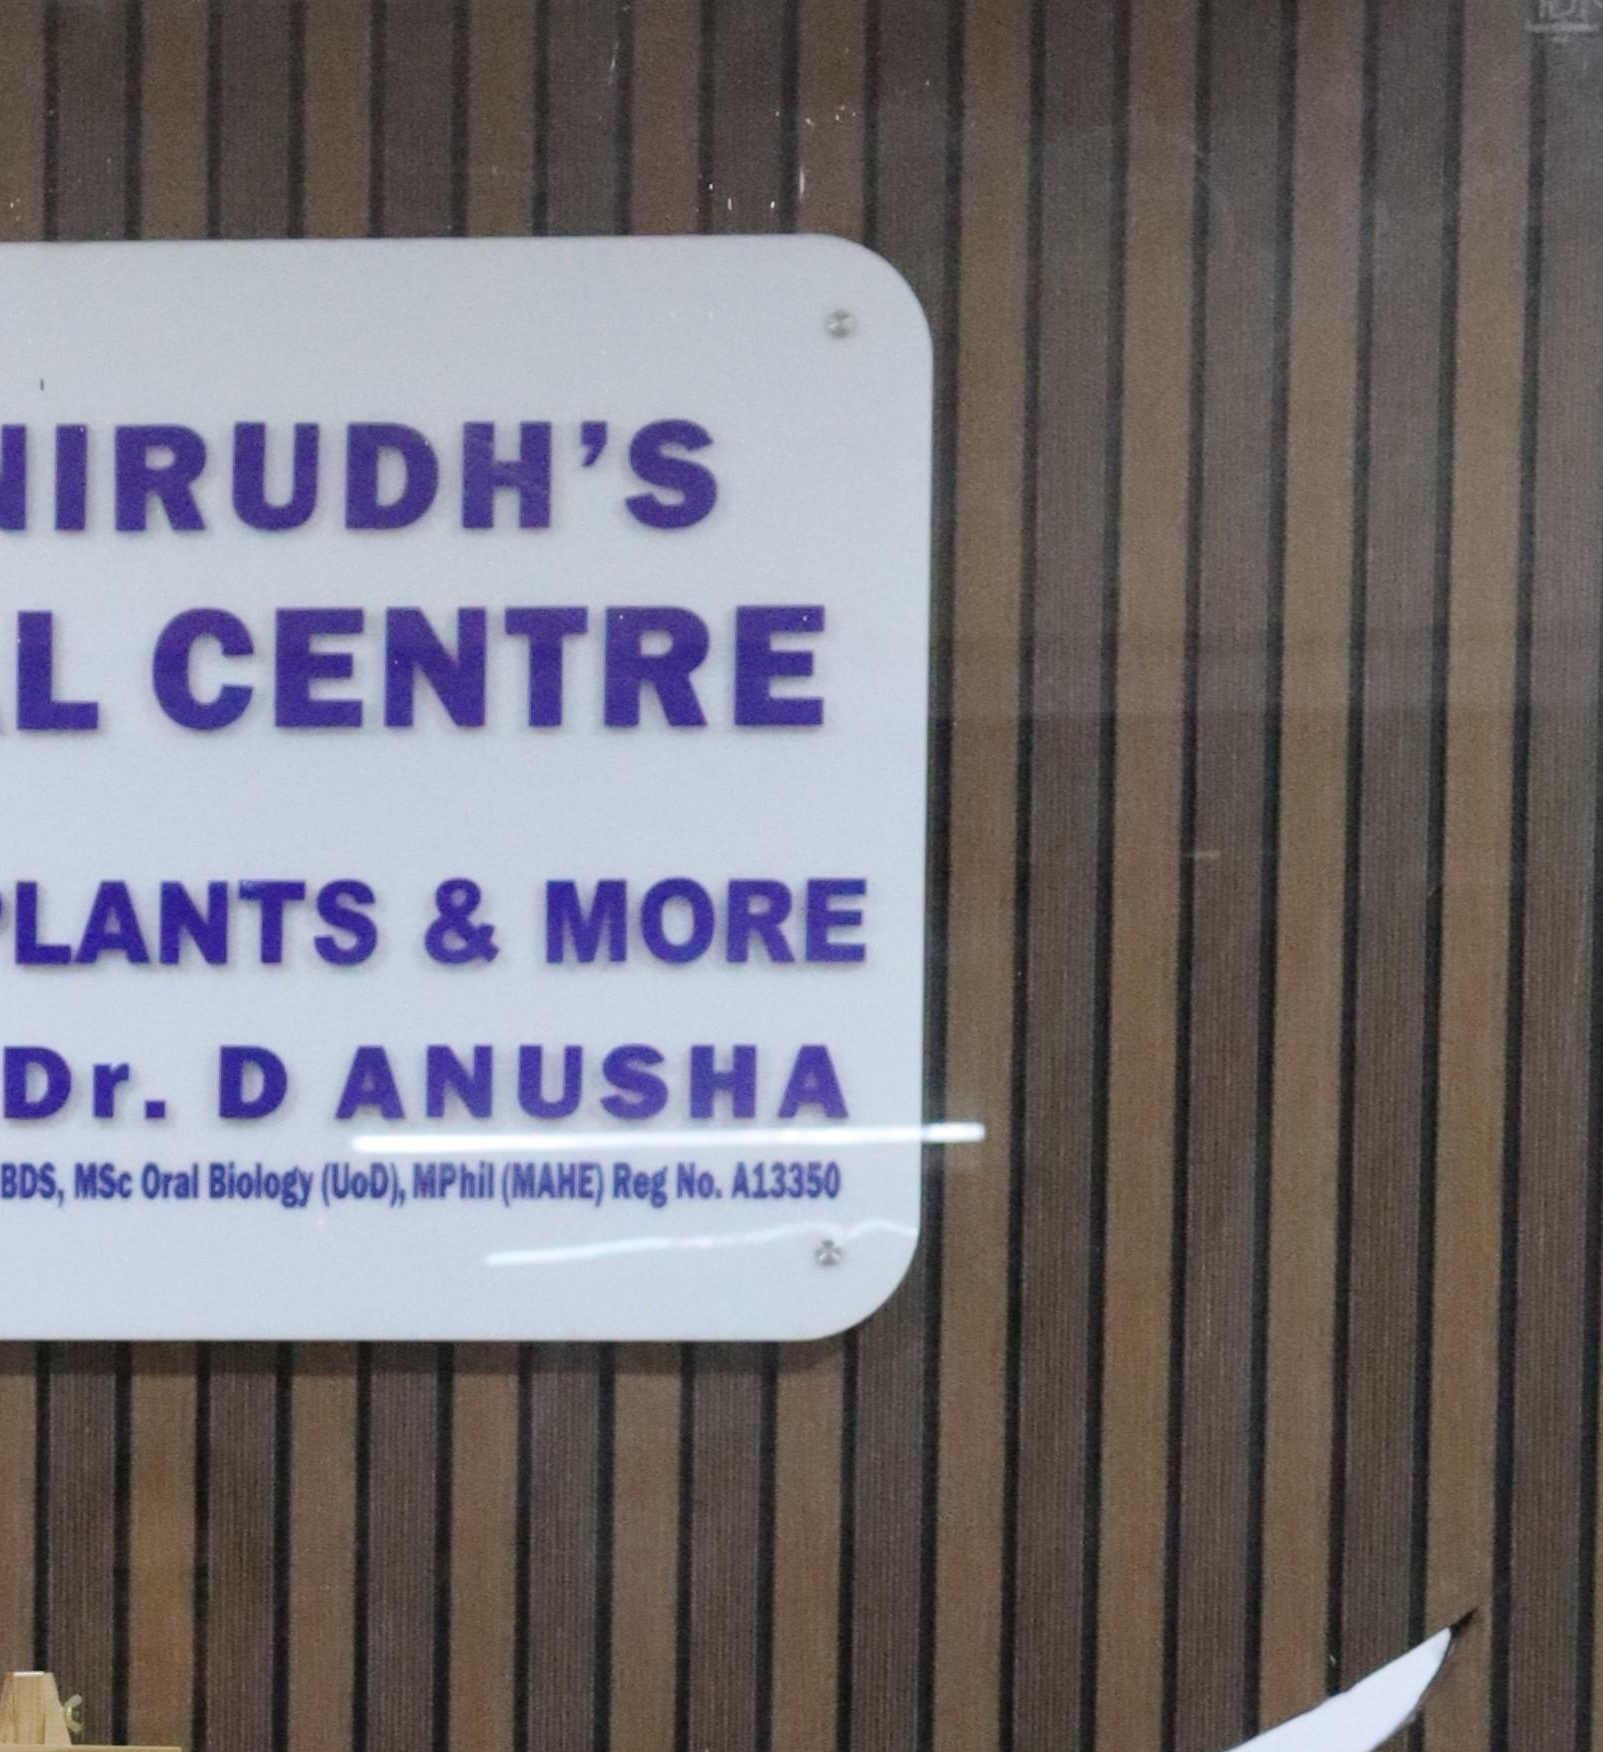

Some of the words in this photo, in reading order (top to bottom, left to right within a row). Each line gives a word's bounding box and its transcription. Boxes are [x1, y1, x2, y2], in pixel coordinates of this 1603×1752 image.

[152, 605, 825, 733] CENTRE
[424, 878, 500, 966] &
[545, 877, 867, 965] MORE
[3, 1046, 166, 1121] Dr.
[218, 1045, 288, 1121] D
[335, 1044, 848, 1122] ANUSHA
[0, 1162, 64, 1203] BDS,
[74, 1162, 133, 1200] MSc
[141, 1162, 199, 1200] Oral
[208, 1162, 314, 1209] Biology
[321, 1162, 406, 1207] (UoD),
[412, 1161, 495, 1199] MPhil
[501, 1162, 604, 1207] (MAHE)
[612, 1162, 668, 1209] Reg
[676, 1162, 722, 1199] No.
[731, 1161, 841, 1200] A13350
